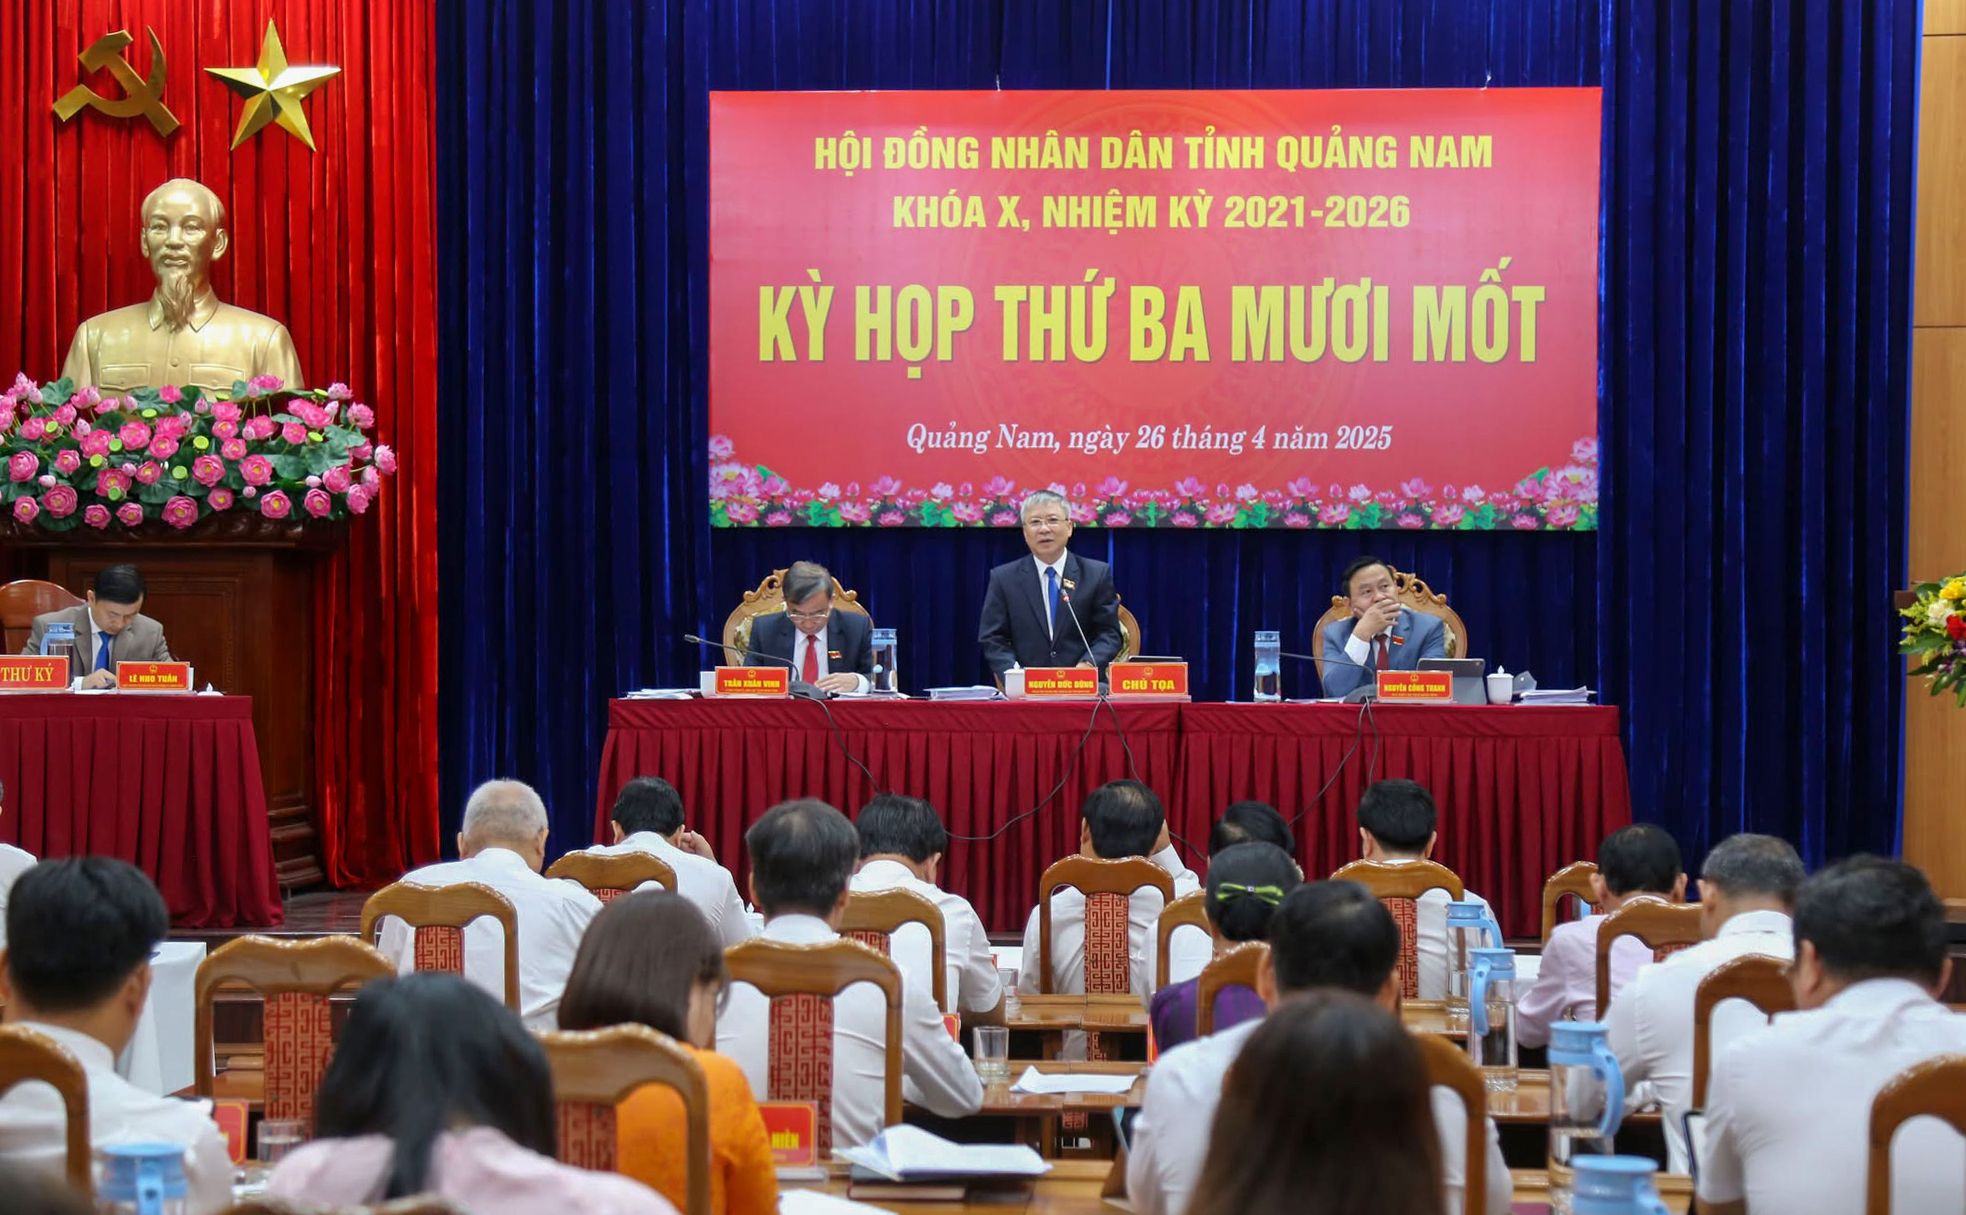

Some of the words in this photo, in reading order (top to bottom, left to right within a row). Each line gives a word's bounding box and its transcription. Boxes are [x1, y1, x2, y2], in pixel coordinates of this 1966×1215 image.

[814, 129, 873, 178] HỘI
[883, 125, 980, 171] ĐỒNG
[990, 129, 1089, 170] NHÂN
[1100, 129, 1174, 170] DÂN
[1184, 125, 1265, 170] TỈNH
[1275, 124, 1398, 174] QUẢNG
[1409, 134, 1493, 169] NAM
[892, 188, 988, 229] KHÓA
[997, 194, 1031, 232] X,
[1042, 189, 1157, 236] NHIỆM
[1168, 188, 1215, 229] KỲ
[1223, 194, 1412, 229] 2021-2026
[758, 268, 835, 363] KỲ
[854, 283, 975, 379] HỌP
[993, 267, 1116, 363] THỨ
[1129, 285, 1211, 362] BA
[1231, 276, 1390, 363] MƯƠI
[1412, 255, 1546, 364] MỐT
[906, 421, 991, 455] Quảng
[995, 423, 1060, 455] Nam,
[1067, 424, 1130, 456] ngày
[1135, 424, 1166, 449] 26
[1172, 424, 1247, 455] tháng
[1251, 425, 1266, 449] 4
[1273, 426, 1328, 450] năm
[1335, 425, 1393, 450] 2025
[1, 665, 33, 682] THƯ
[35, 662, 54, 682] KÝ
[1122, 678, 1148, 690] CHỦ
[1152, 679, 1175, 692] TỌA
